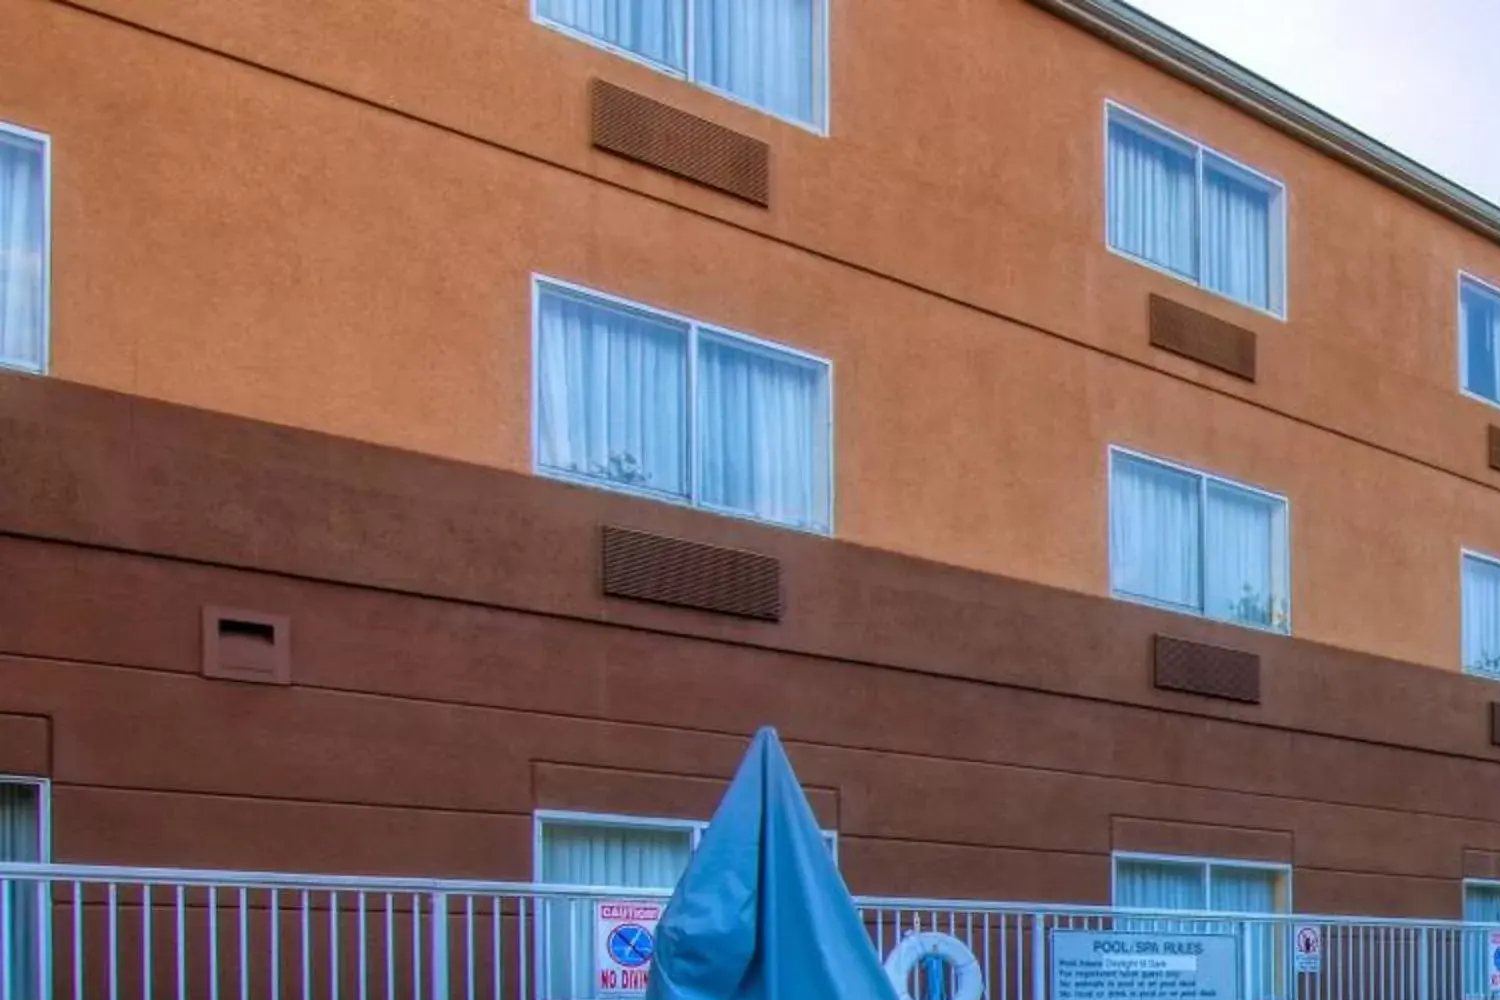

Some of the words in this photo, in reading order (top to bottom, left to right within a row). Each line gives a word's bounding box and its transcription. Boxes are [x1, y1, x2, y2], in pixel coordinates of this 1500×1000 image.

[1163, 942, 1204, 955] RULES
[602, 970, 616, 988] NO
[622, 970, 648, 988] DIVIN
